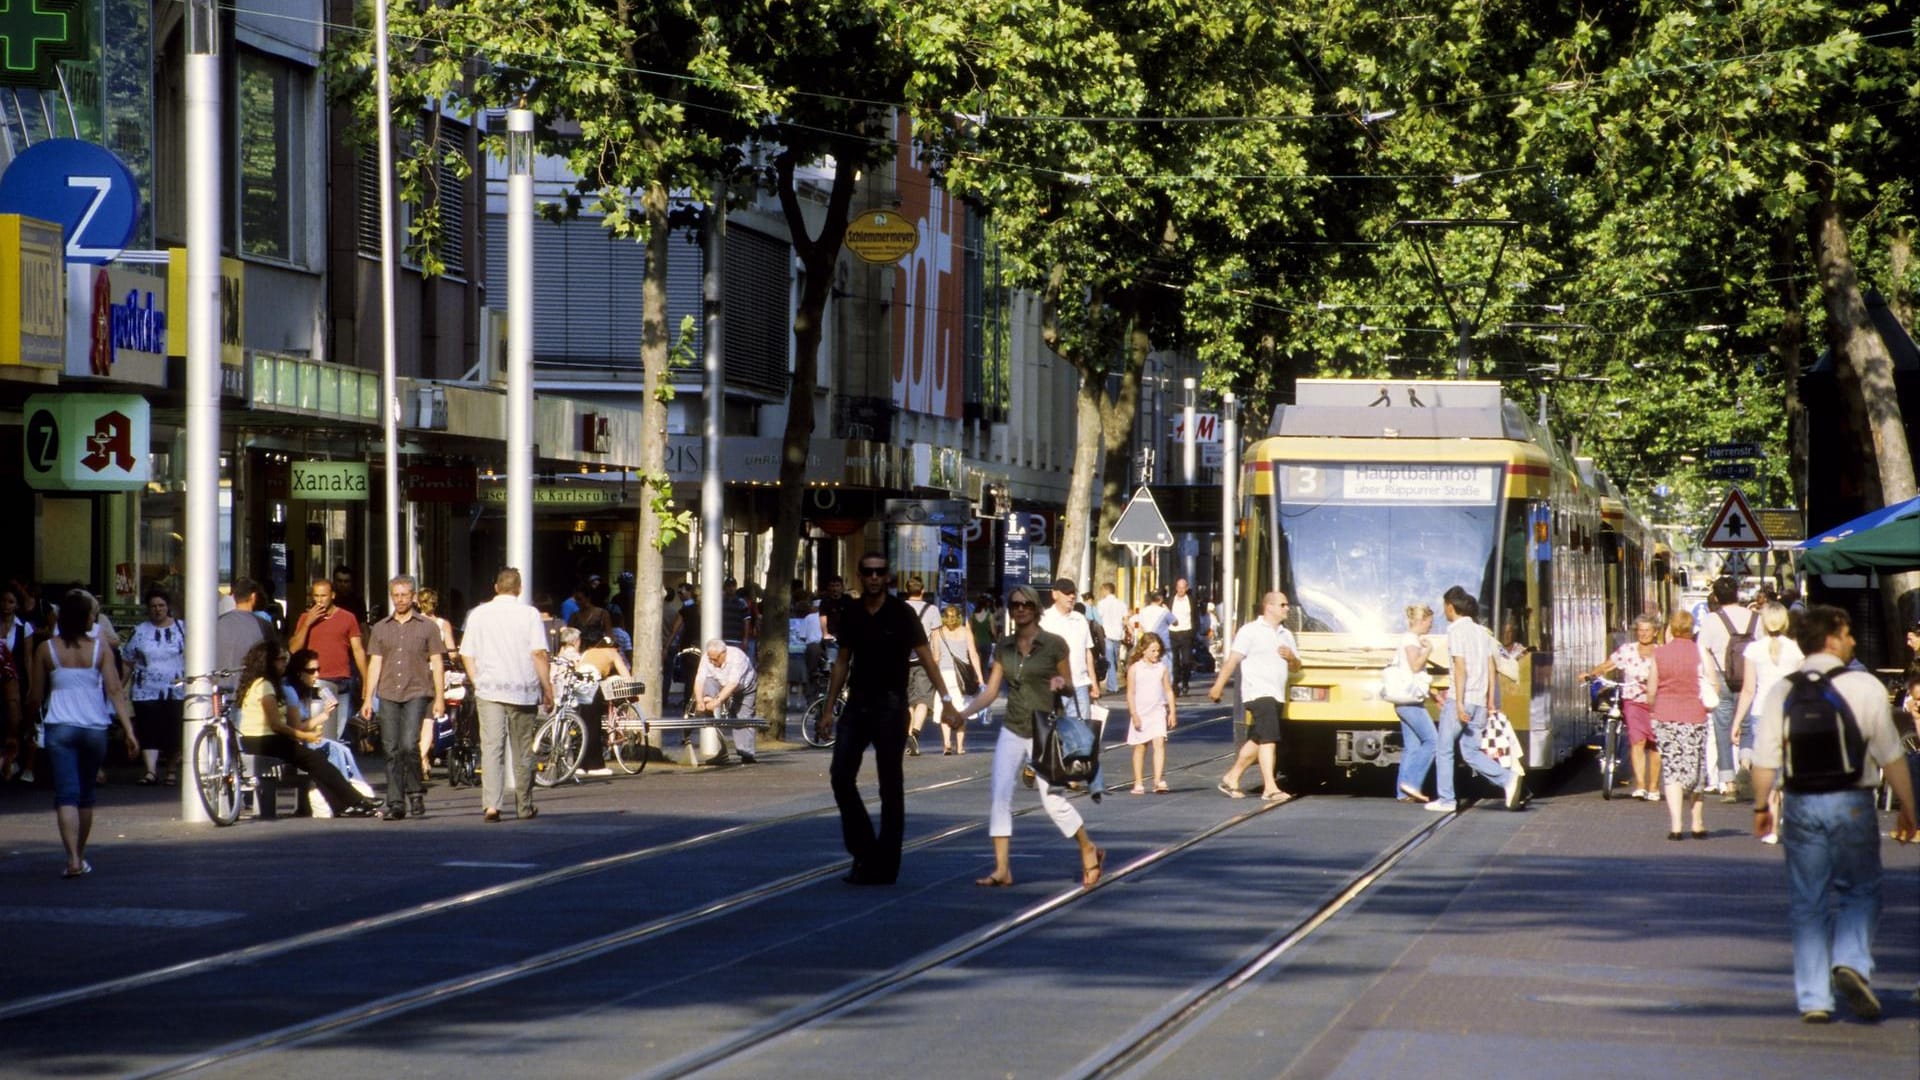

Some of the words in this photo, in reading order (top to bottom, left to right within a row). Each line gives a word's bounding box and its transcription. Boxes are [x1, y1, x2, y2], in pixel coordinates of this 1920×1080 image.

[66, 176, 124, 260] Z
[40, 426, 58, 466] Z
[293, 468, 366, 491] Xanaka
[1298, 466, 1317, 494] 3
[1355, 464, 1478, 485] Hauptbahnhof
[548, 486, 618, 502] Karlsruhe
